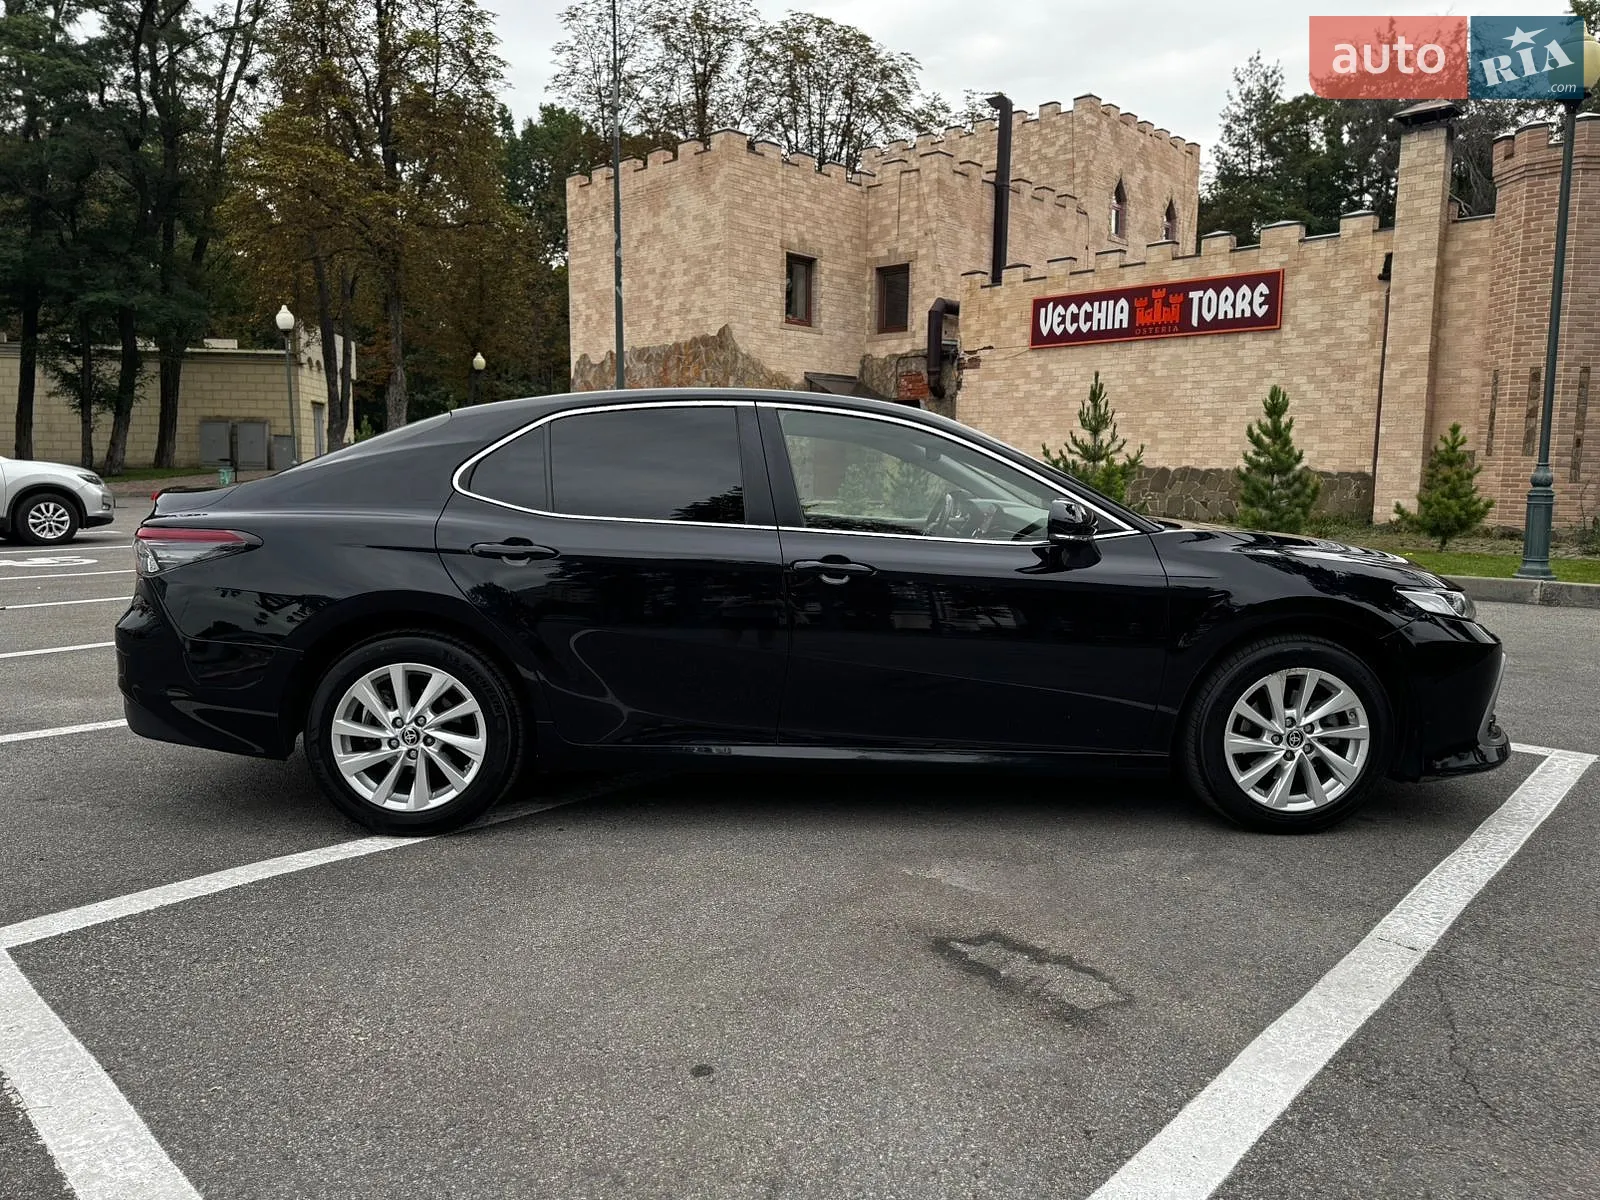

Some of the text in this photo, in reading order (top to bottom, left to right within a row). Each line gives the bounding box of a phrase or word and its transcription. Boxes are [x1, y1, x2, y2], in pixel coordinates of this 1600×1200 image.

[1039, 282, 1270, 337] VECCHIA TORRE
[1135, 325, 1179, 335] OSTERIA
